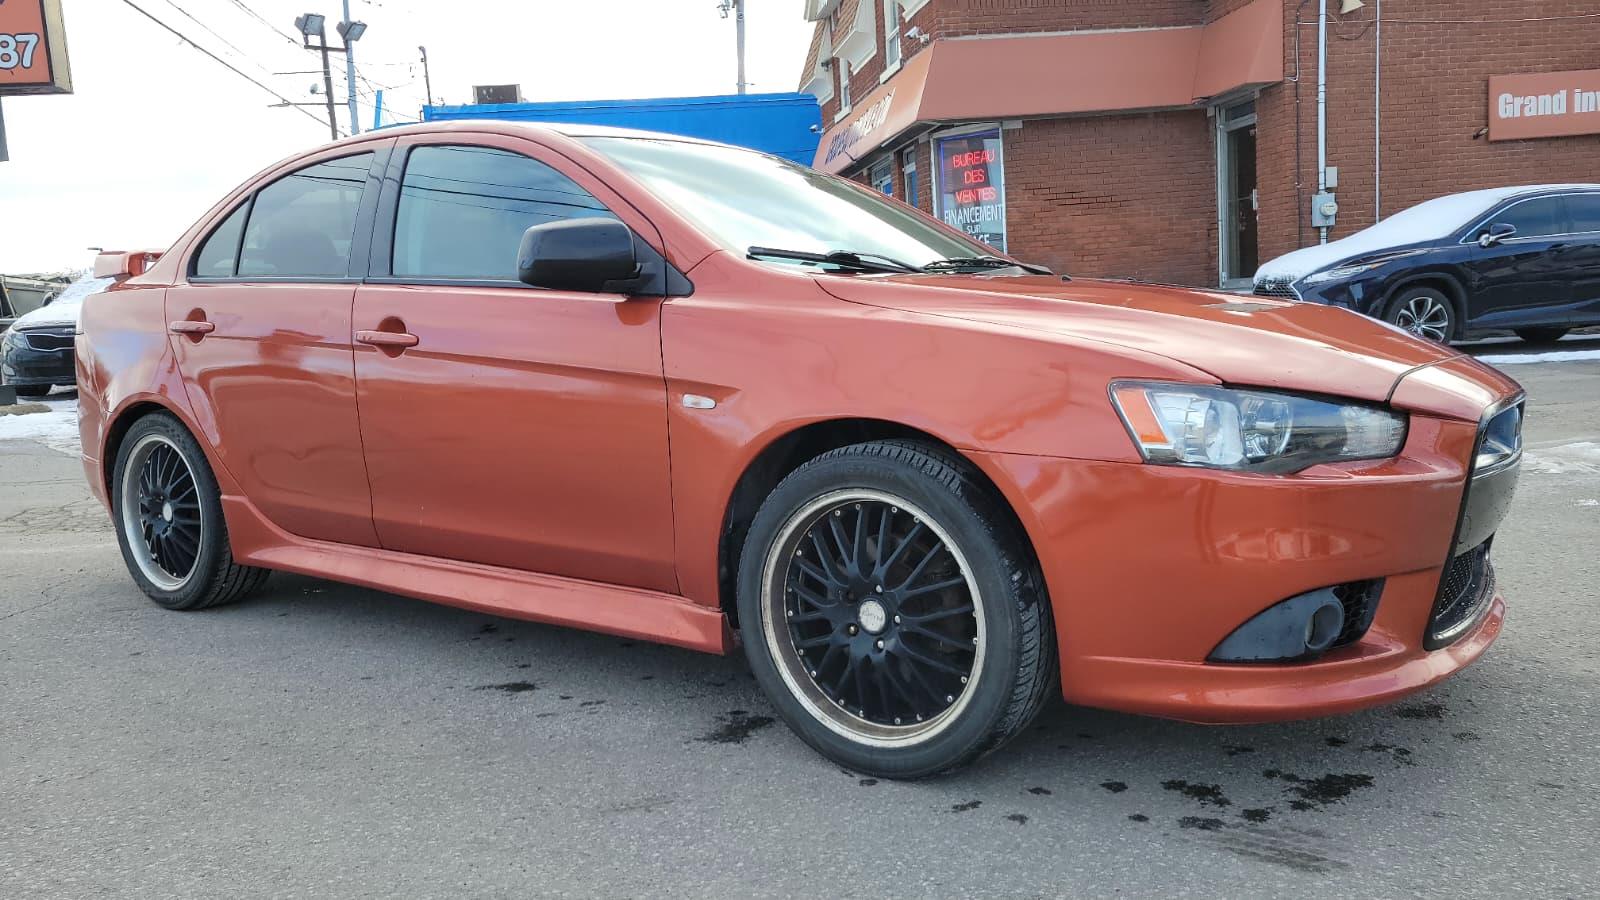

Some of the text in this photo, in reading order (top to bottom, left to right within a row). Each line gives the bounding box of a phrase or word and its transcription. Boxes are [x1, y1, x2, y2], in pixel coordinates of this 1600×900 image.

[0, 32, 40, 70] 87
[1498, 89, 1567, 119] Grand
[952, 148, 995, 168] BUREAU
[964, 169, 985, 185] DES
[955, 186, 997, 204] VENTES
[944, 204, 1002, 224] FINANCEMENT
[966, 224, 981, 234] SUR
